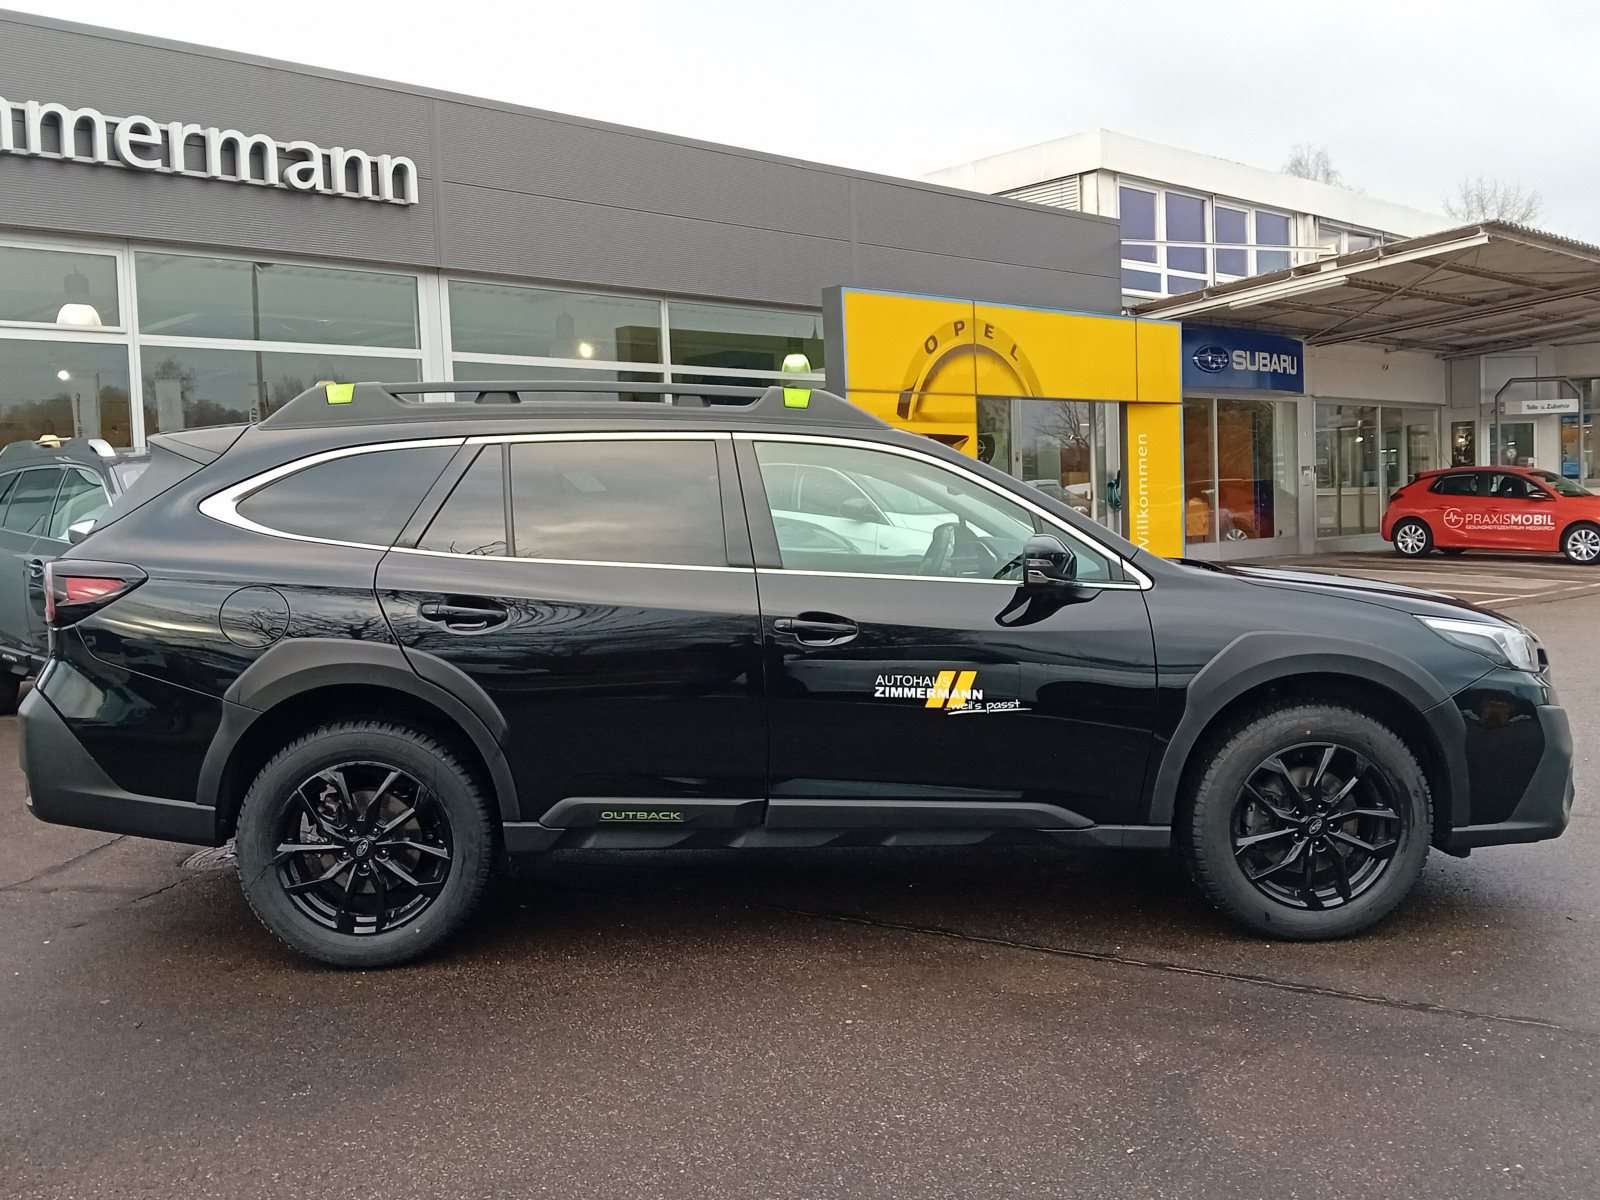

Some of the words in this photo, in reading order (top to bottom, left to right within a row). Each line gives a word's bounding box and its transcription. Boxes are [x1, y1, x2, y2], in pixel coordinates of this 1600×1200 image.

[924, 320, 1018, 362] OPEL
[1232, 350, 1297, 375] SUBARU
[1465, 513, 1555, 525] PRAXISMOBIL
[875, 674, 950, 687] AUTOHAUS
[874, 686, 984, 700] ZIMMERMANN
[986, 699, 1021, 714] passt
[601, 811, 681, 820] OUTBACK
